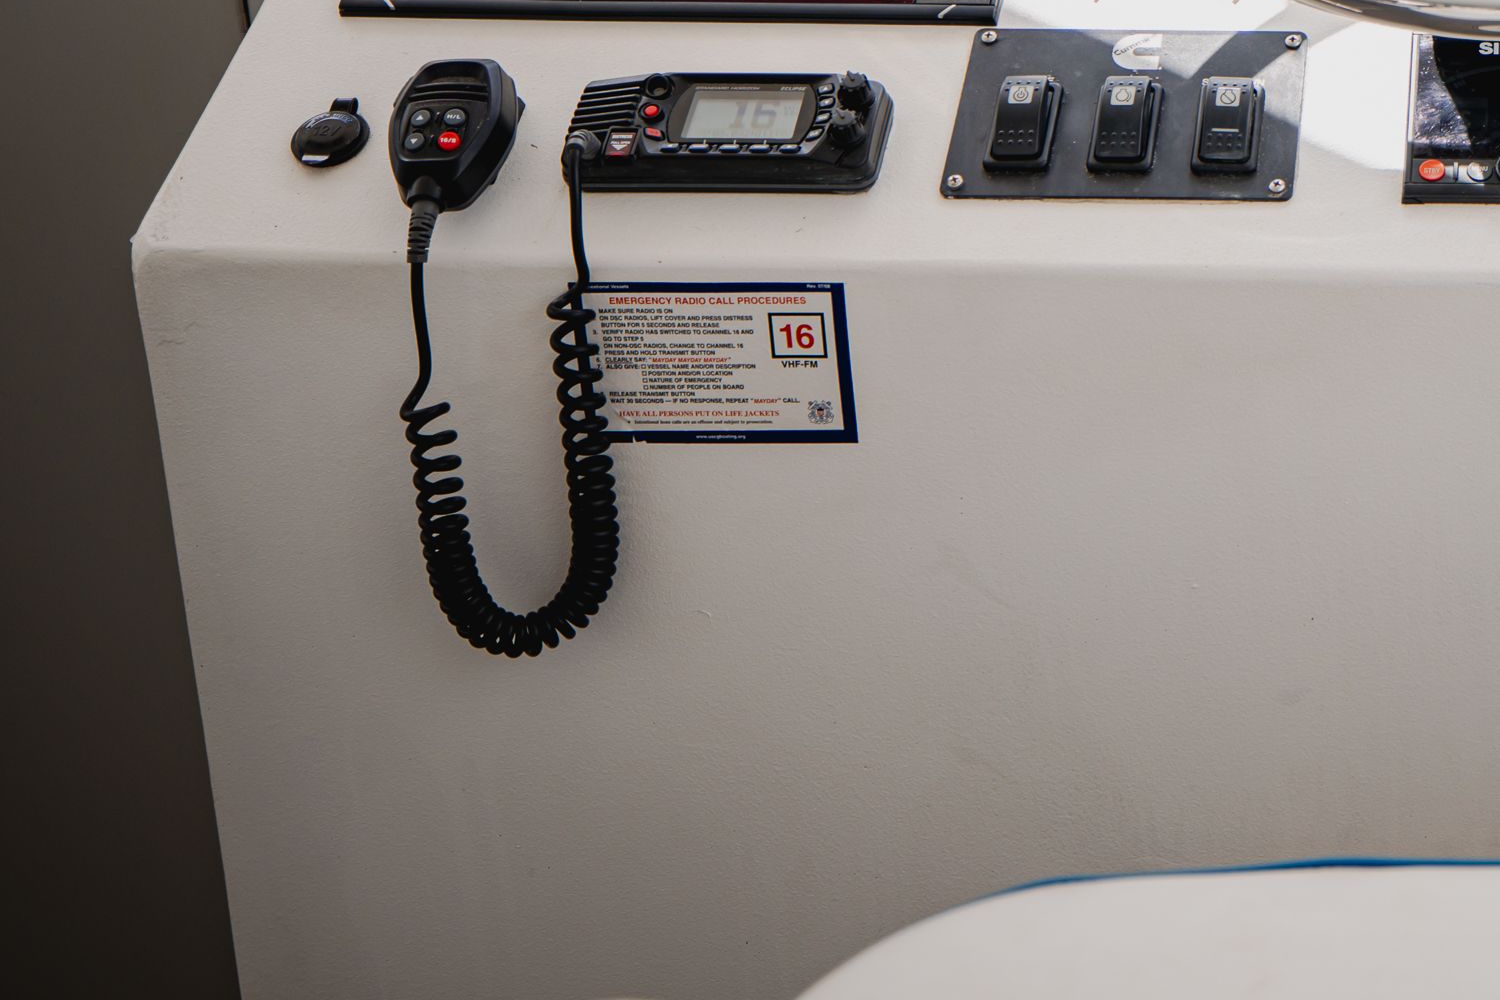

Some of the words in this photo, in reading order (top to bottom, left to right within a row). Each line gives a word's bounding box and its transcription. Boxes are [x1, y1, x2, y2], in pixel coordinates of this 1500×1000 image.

[729, 100, 777, 129] 16
[609, 297, 671, 305] EMERGENCY
[674, 297, 706, 305] RADIO
[708, 297, 735, 305] CALL
[738, 297, 806, 305] PROCEDURES
[779, 324, 815, 349] 16
